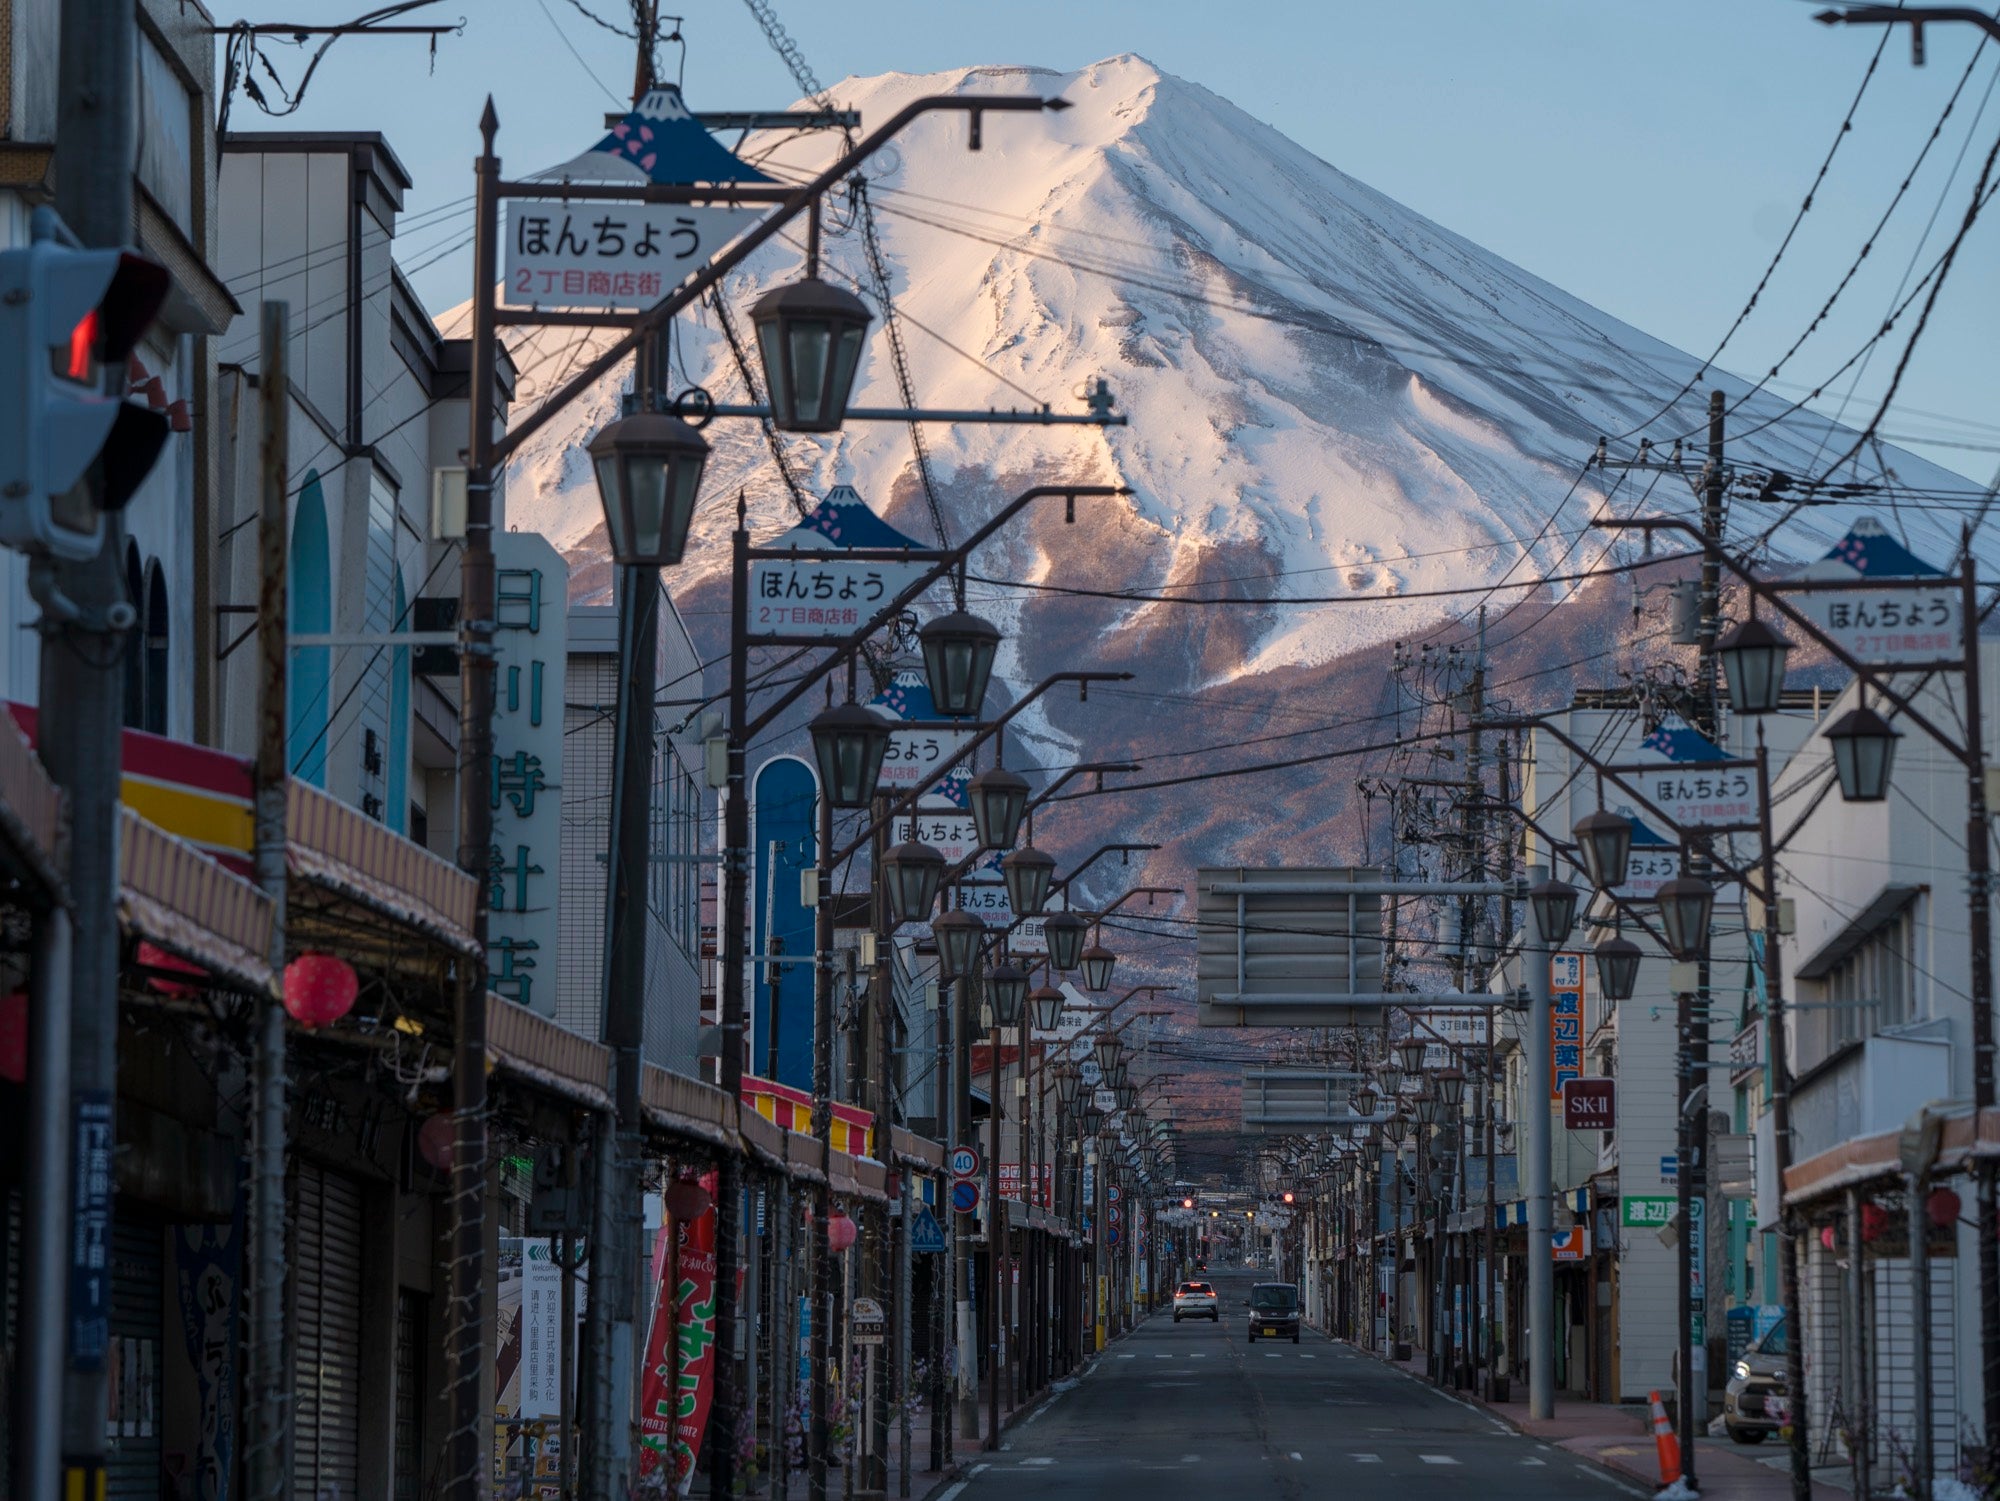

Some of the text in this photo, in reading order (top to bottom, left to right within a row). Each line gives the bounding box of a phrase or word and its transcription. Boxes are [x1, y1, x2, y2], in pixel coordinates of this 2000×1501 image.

[519, 216, 700, 259] ほんちょう
[516, 268, 662, 297] 2丁目商店街
[761, 570, 884, 601] ほんちょう
[759, 607, 859, 625] 2丁目商店街
[1829, 598, 1951, 629] ほんちょう
[884, 738, 940, 762] ちょう
[879, 766, 920, 781] 商店街
[1657, 775, 1749, 801] ほんちょう
[1630, 857, 1674, 875] ちょう
[959, 891, 1009, 909] ほんちょ
[955, 1155, 972, 1169] 40
